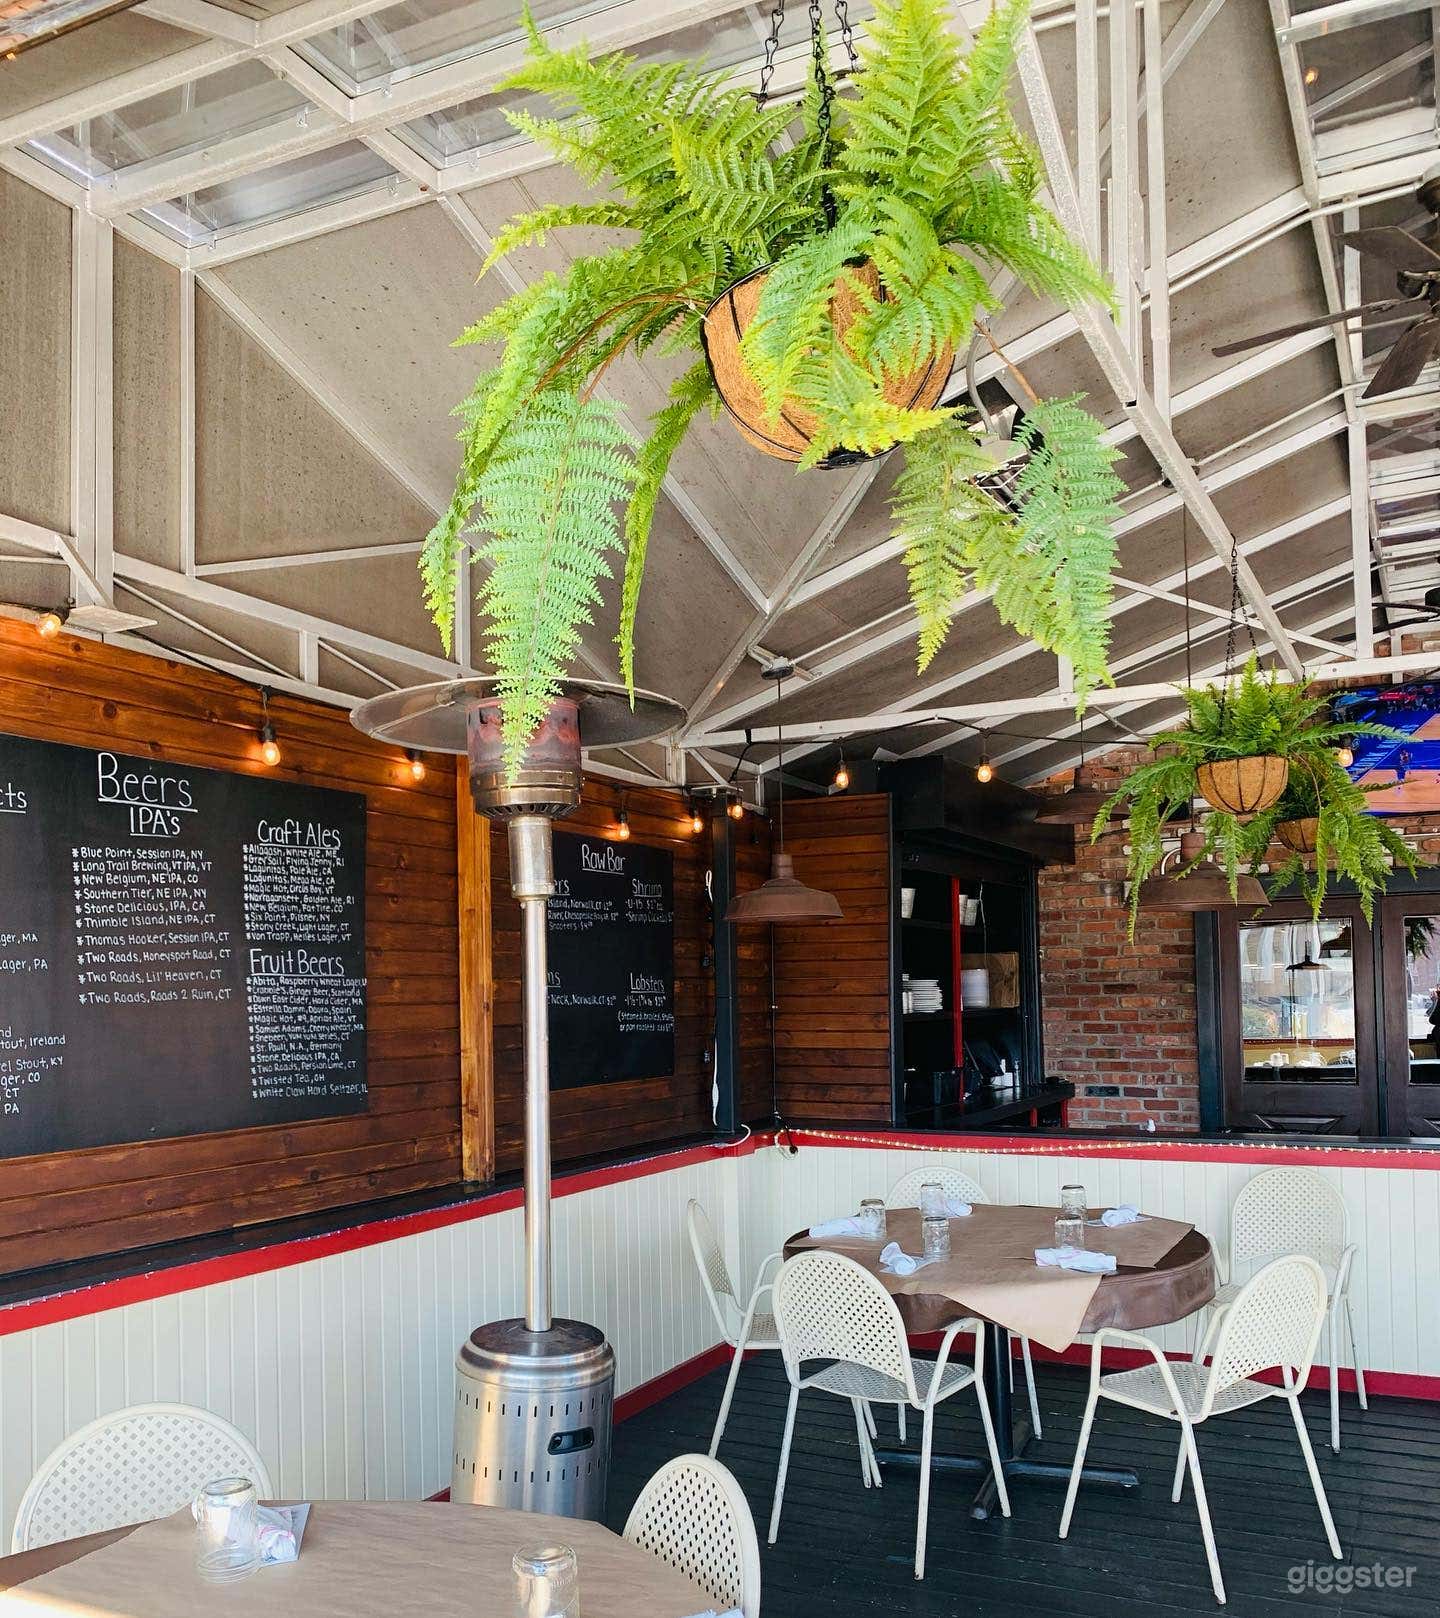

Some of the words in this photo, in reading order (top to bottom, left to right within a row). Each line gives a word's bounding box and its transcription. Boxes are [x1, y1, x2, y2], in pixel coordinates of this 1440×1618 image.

[98, 752, 193, 807] Beers
[130, 807, 181, 835] IPA's
[258, 819, 301, 845] Craft
[306, 822, 341, 848] Ales
[81, 847, 102, 858] Blue
[105, 847, 136, 859] Point,
[136, 849, 170, 859] Session
[173, 850, 189, 860] IPA,
[191, 850, 203, 859] NY
[326, 850, 337, 858] ME
[582, 844, 605, 869] Raw
[607, 847, 626, 871] Bar
[81, 862, 105, 874] Long
[106, 861, 129, 871] Trail
[132, 861, 171, 875] Brewing,
[172, 861, 182, 870] VT
[184, 862, 200, 872] IPA,
[201, 862, 212, 871] VT
[322, 867, 332, 875] CA
[82, 874, 103, 886] New
[106, 873, 150, 887] Belgium,
[152, 874, 165, 884] NE
[169, 874, 185, 884] IPA,
[187, 874, 198, 883] CO
[326, 877, 335, 885] CA
[84, 888, 129, 900] Southern
[131, 888, 154, 900] Tier,
[156, 888, 170, 898] NE
[173, 888, 192, 899] IPA,
[194, 888, 207, 898] NY
[326, 886, 335, 894] VT
[346, 896, 355, 904] RI
[85, 903, 114, 914] Stone
[117, 902, 168, 913] Delicious,
[170, 902, 189, 912] IPA,
[192, 901, 205, 911] CA
[250, 903, 266, 911] New
[84, 916, 128, 928] Thimble
[169, 915, 182, 924] NE
[185, 914, 203, 925] IPA,
[205, 914, 216, 923] CT
[251, 912, 262, 920] Six
[251, 922, 273, 932] Stony
[341, 923, 349, 931] CT
[22, 933, 38, 942] MA
[85, 934, 125, 946] Thomas
[128, 933, 168, 945] Hooker,
[169, 932, 200, 943] Session
[201, 932, 218, 943] IPA,
[219, 932, 229, 942] CT
[252, 932, 265, 940] Von
[85, 952, 105, 963] Two
[109, 951, 142, 963] Roads,
[143, 950, 191, 962] Honeyspot
[193, 950, 217, 961] Road,
[220, 949, 231, 958] CT
[34, 959, 48, 969] PA
[250, 948, 294, 974] Fruit
[297, 949, 344, 976] Beers
[86, 972, 106, 983] Two
[110, 971, 144, 984] Roads,
[165, 971, 208, 982] Heaven,
[210, 969, 222, 979] CT
[630, 972, 664, 992] Lobsters
[87, 992, 110, 1004] Two
[114, 991, 150, 1003] Roads,
[150, 990, 178, 1001] Roads
[181, 989, 188, 1000] 2
[192, 988, 218, 1001] Ruin,
[219, 989, 232, 999] CT
[30, 1034, 65, 1046] Ireland
[341, 1032, 350, 1040] CT
[331, 1053, 339, 1061] CA
[0, 1061, 12, 1072] el
[16, 1057, 49, 1070] Stout,
[51, 1056, 63, 1065] KY
[257, 1065, 272, 1073] Two
[28, 1072, 40, 1082] CO
[260, 1075, 292, 1085] Twisted
[6, 1088, 19, 1098] CT
[5, 1103, 19, 1114] PA
